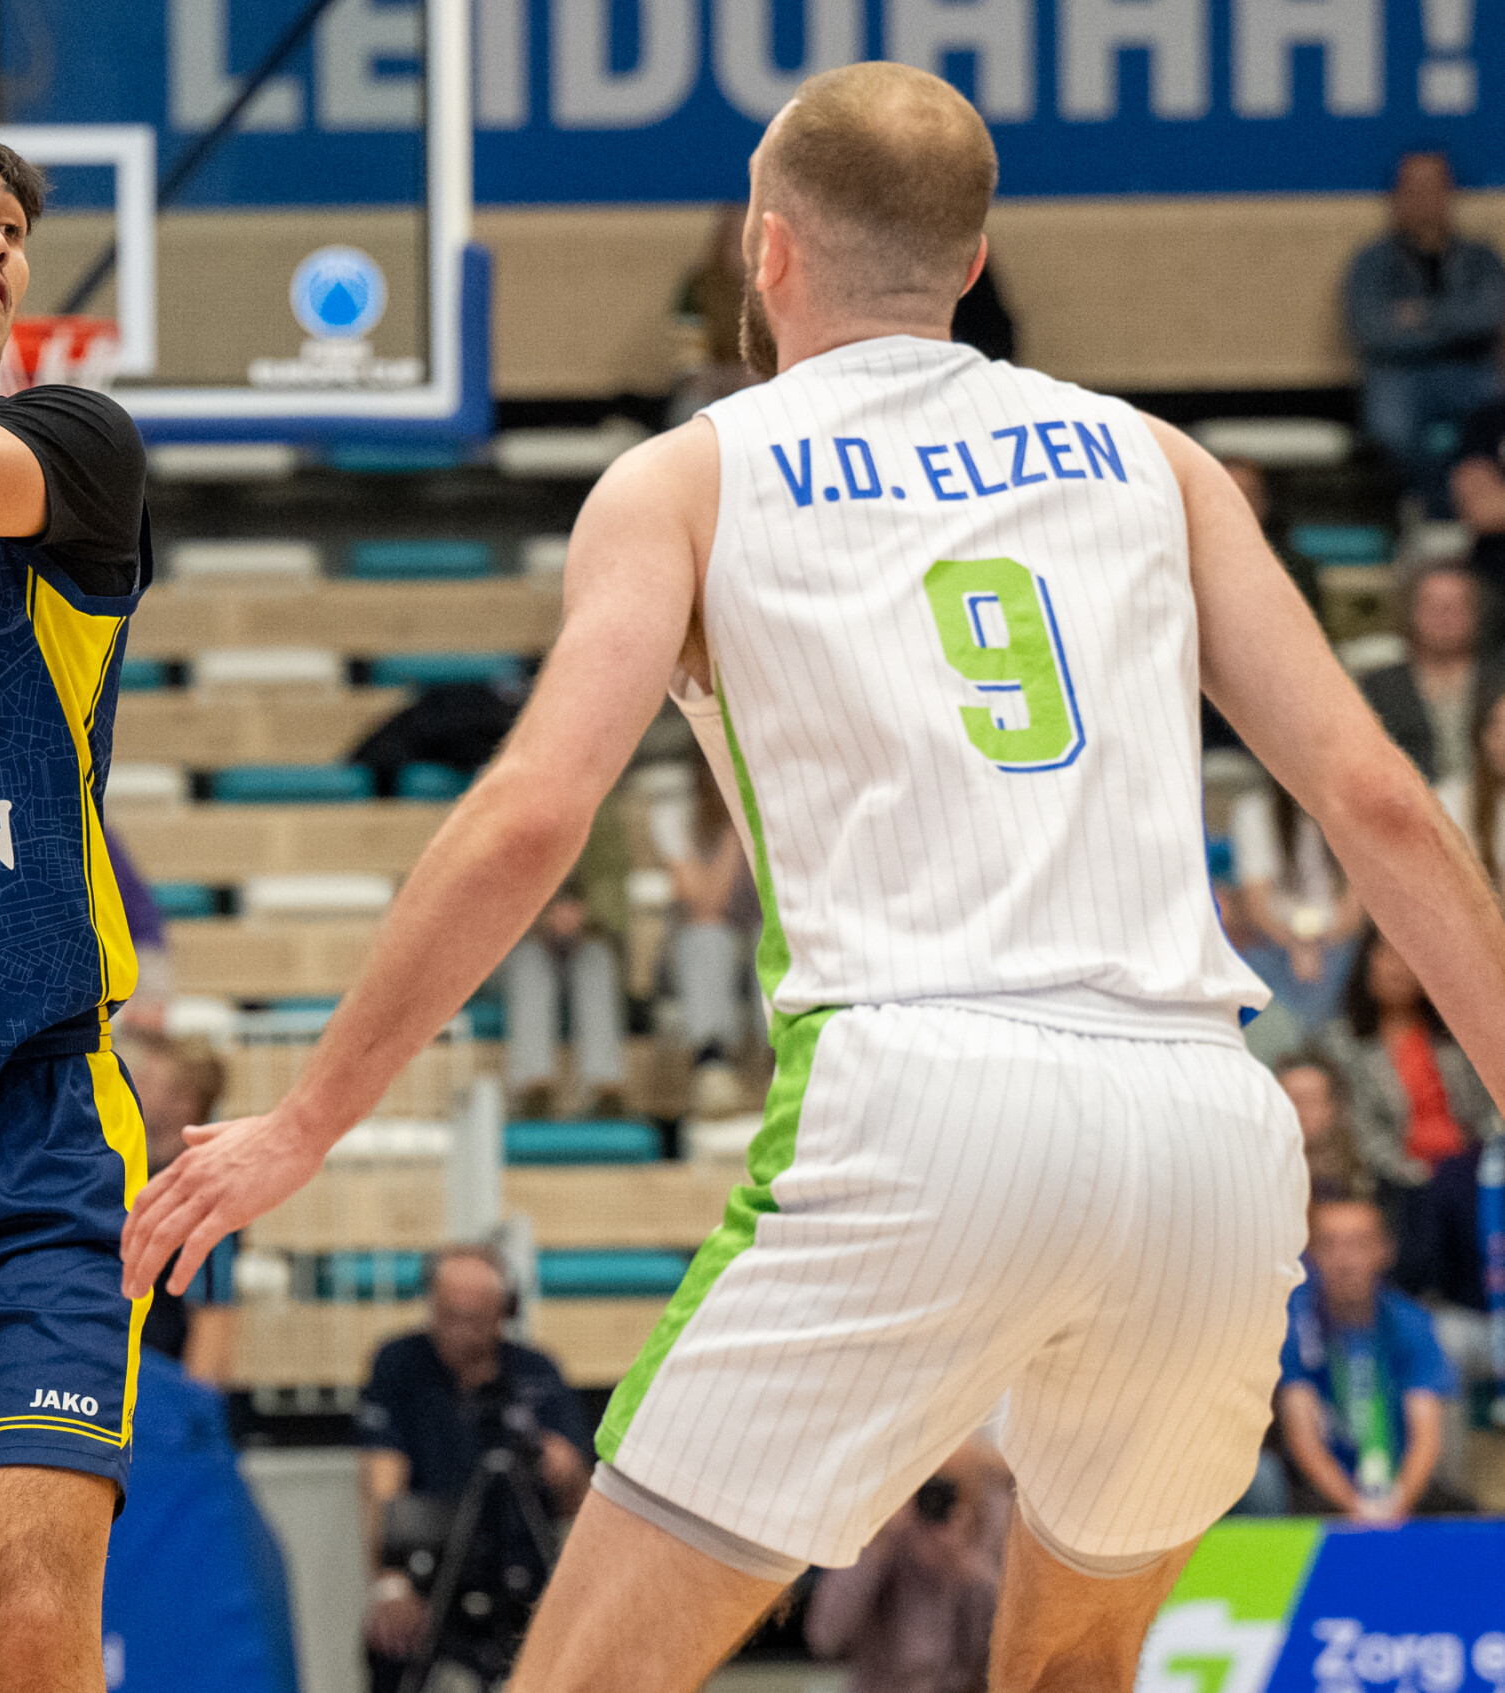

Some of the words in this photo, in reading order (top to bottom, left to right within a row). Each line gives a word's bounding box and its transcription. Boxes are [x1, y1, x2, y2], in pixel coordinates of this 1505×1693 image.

[770, 437, 907, 508] V.D.
[914, 420, 1129, 502] ELZEN
[923, 556, 1087, 775] 9
[29, 1388, 99, 1417] JAKO
